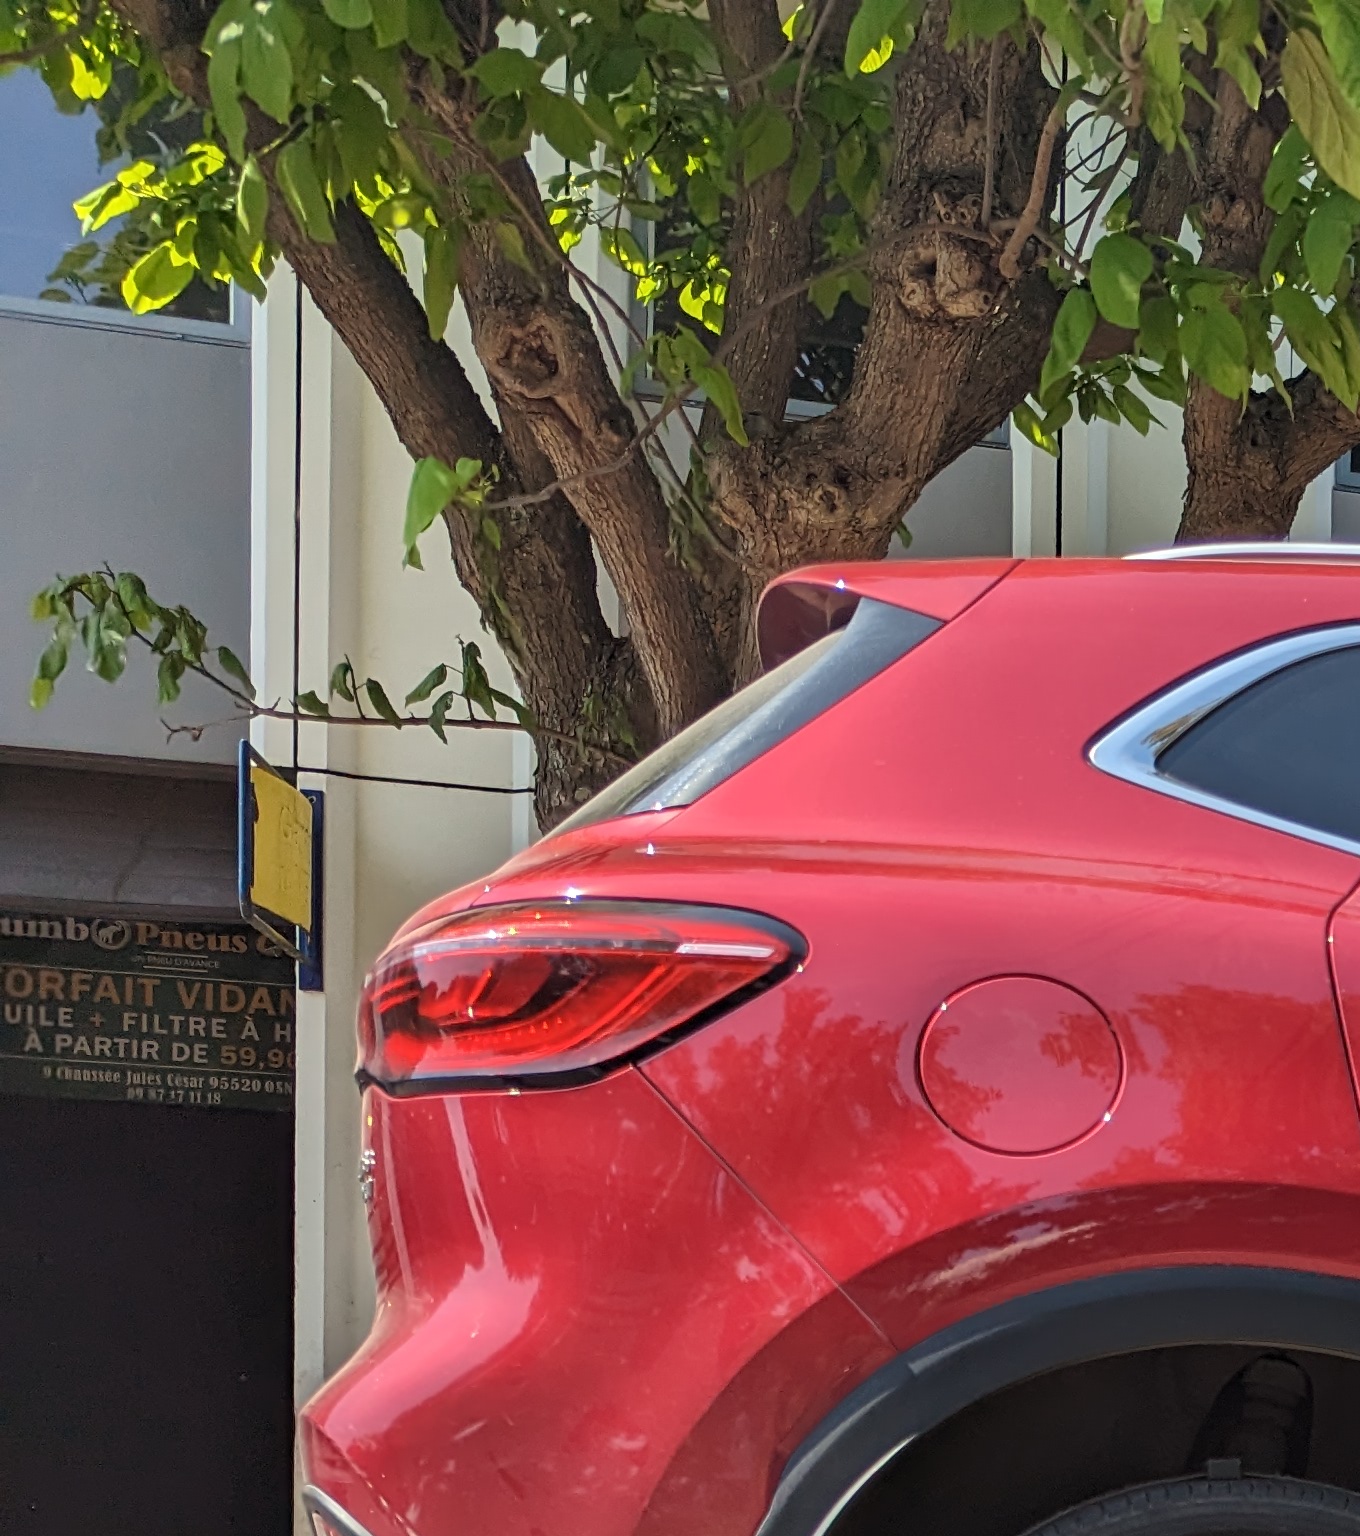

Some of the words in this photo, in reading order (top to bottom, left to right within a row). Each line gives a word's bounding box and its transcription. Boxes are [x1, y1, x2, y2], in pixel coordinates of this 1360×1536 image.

[136, 921, 248, 954] Pneus
[1, 967, 161, 1007] ORFAIT
[3, 1003, 74, 1028] UILE
[123, 1012, 227, 1040] FILTRE
[240, 1016, 259, 1042] À
[24, 1028, 43, 1053] À
[55, 1033, 160, 1062] PARTIR
[171, 1042, 209, 1065] DE
[126, 1069, 162, 1087] Jules
[209, 1075, 262, 1094] 95520
